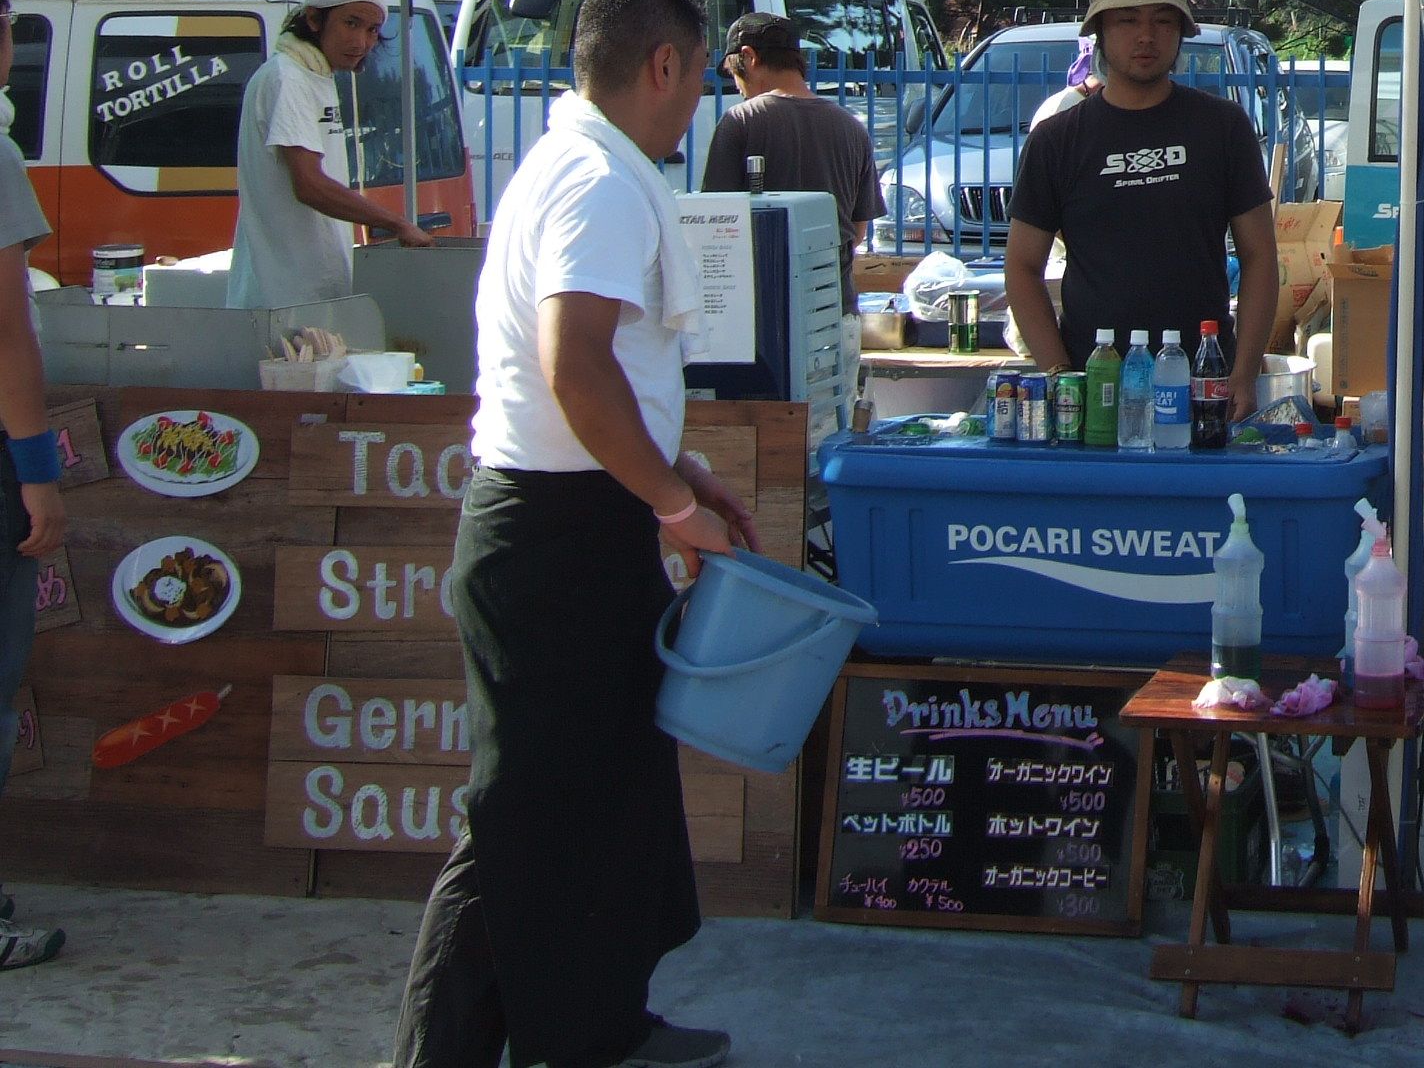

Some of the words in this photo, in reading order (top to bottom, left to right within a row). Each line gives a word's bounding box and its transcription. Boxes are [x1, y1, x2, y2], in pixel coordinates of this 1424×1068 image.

[103, 45, 192, 92] ROLL
[97, 57, 230, 124] TORTILLA
[947, 524, 1082, 556] POCARI
[1091, 527, 1221, 559] SWEAT
[883, 688, 1002, 728] Drinks
[1004, 690, 1099, 729] Menu
[846, 757, 952, 782] 生ビール
[988, 763, 1112, 785] オーガニックワイン
[901, 787, 946, 808] ¥500
[1060, 790, 1106, 811] ¥500
[842, 813, 951, 834] ペットボトル
[988, 816, 1100, 838] ホットワイン
[900, 838, 943, 860] ¥250
[907, 876, 953, 893] カクテル
[984, 864, 1107, 888] オーガニックコーヒー
